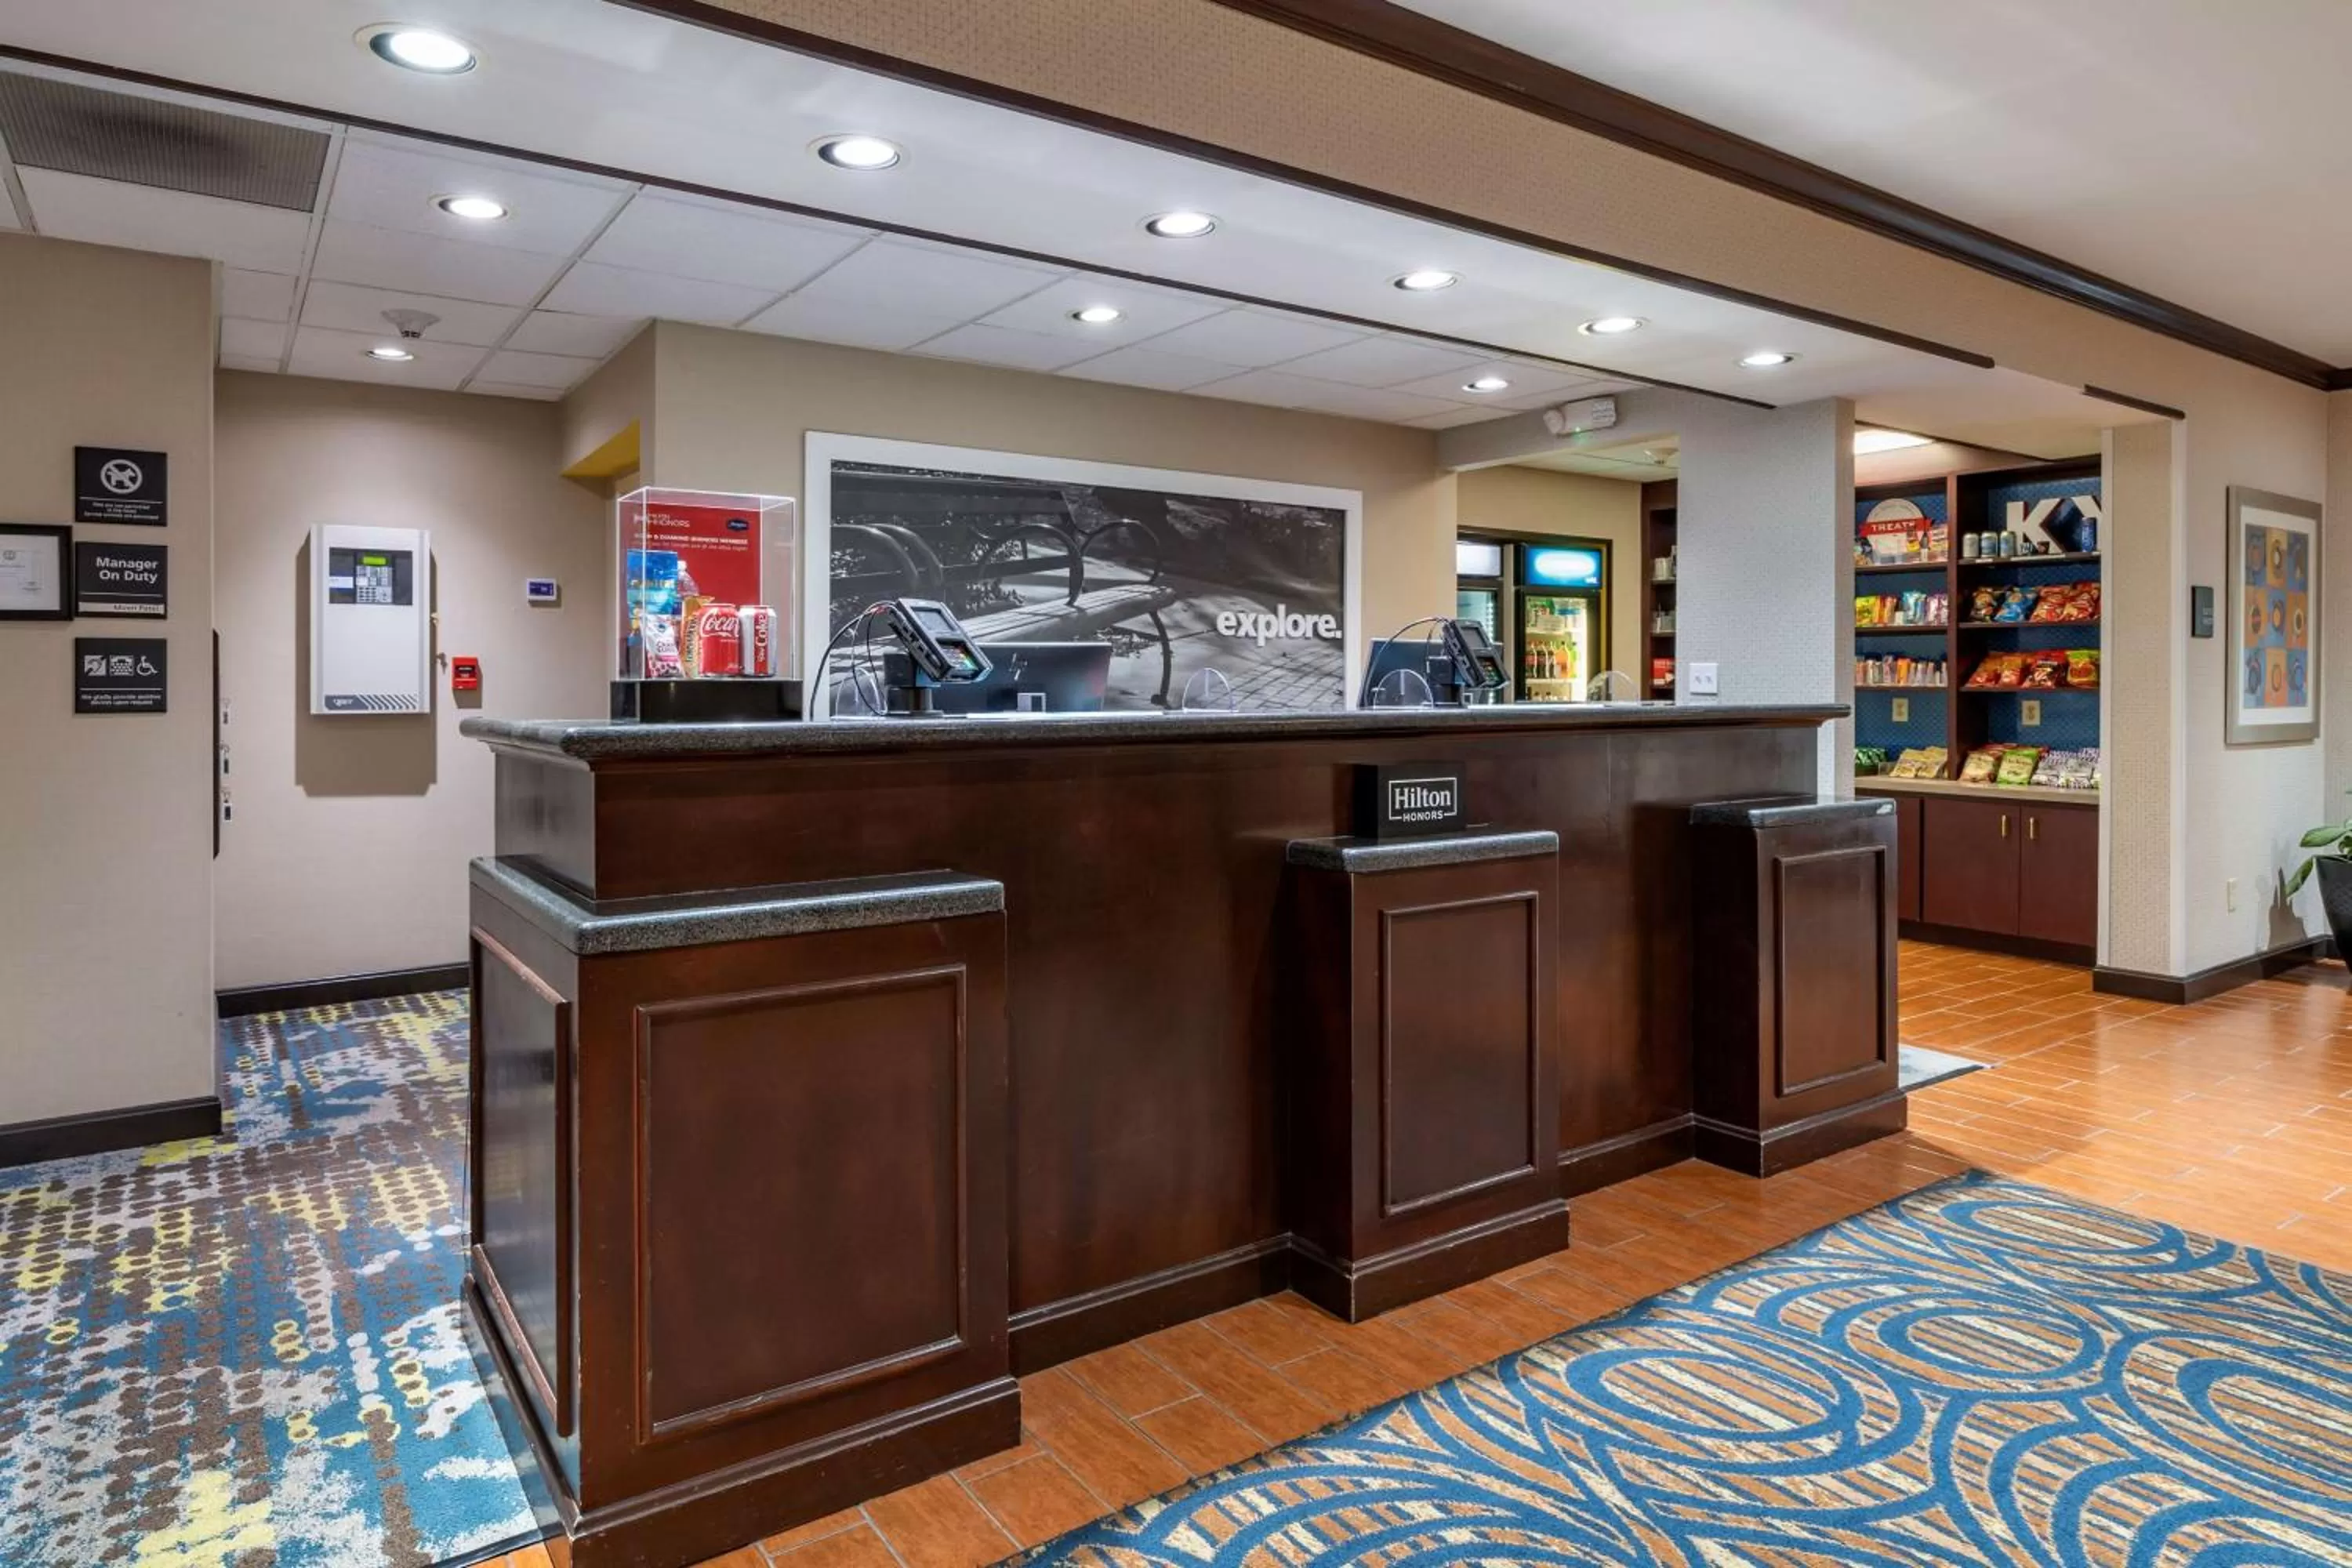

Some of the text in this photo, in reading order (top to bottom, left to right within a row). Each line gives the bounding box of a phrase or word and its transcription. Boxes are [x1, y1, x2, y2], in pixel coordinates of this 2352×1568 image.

[96, 557, 158, 571] Manager
[100, 570, 158, 583] On Duty
[1217, 604, 1342, 647] explore.
[1394, 787, 1451, 810] Hilton
[1403, 811, 1443, 822] HONORS
